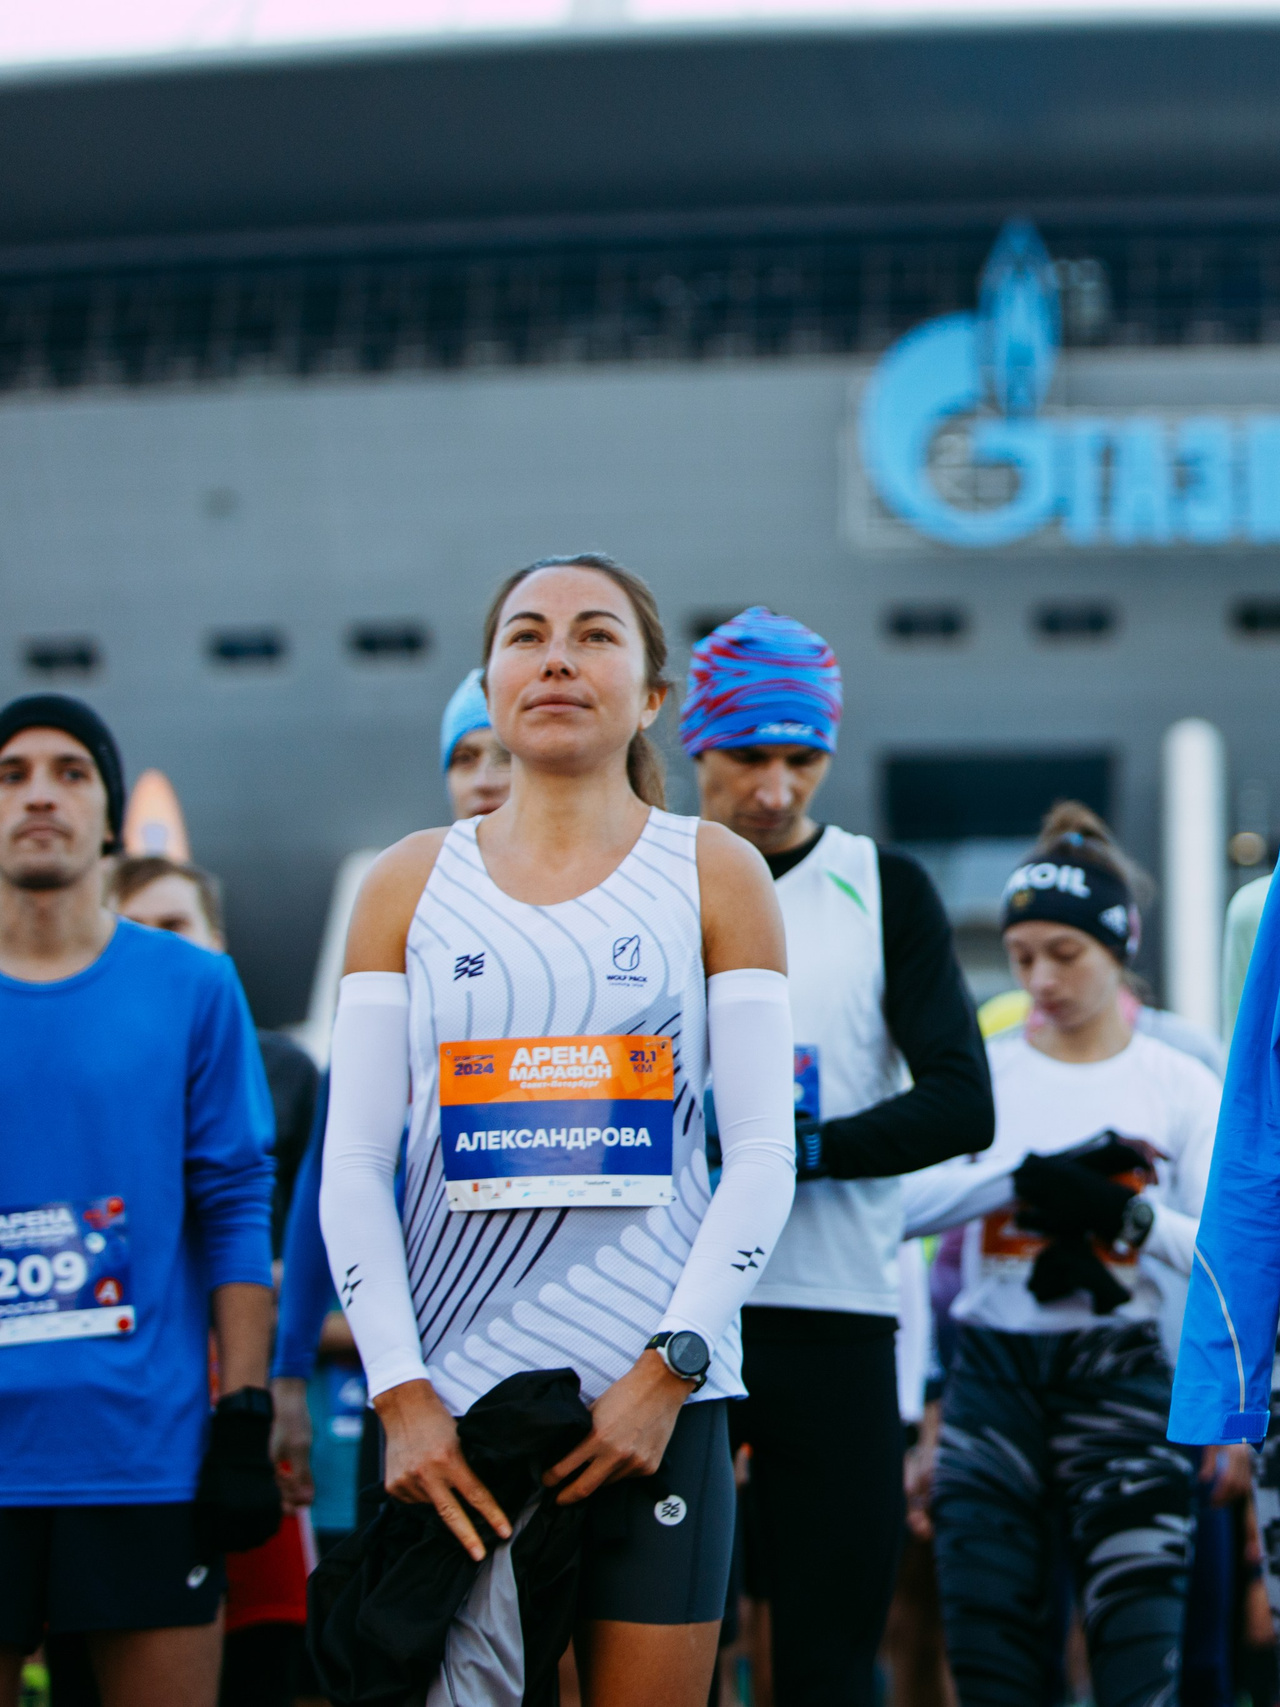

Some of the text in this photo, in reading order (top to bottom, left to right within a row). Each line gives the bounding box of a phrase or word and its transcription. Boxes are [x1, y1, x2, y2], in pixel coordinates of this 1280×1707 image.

[511, 1045, 609, 1066] АРЕНА
[629, 1050, 657, 1063] 21,1
[454, 1062, 494, 1076] 2024
[509, 1064, 612, 1081] МАРАФОН
[454, 1127, 652, 1152] АЛЕКСАНДРОВА
